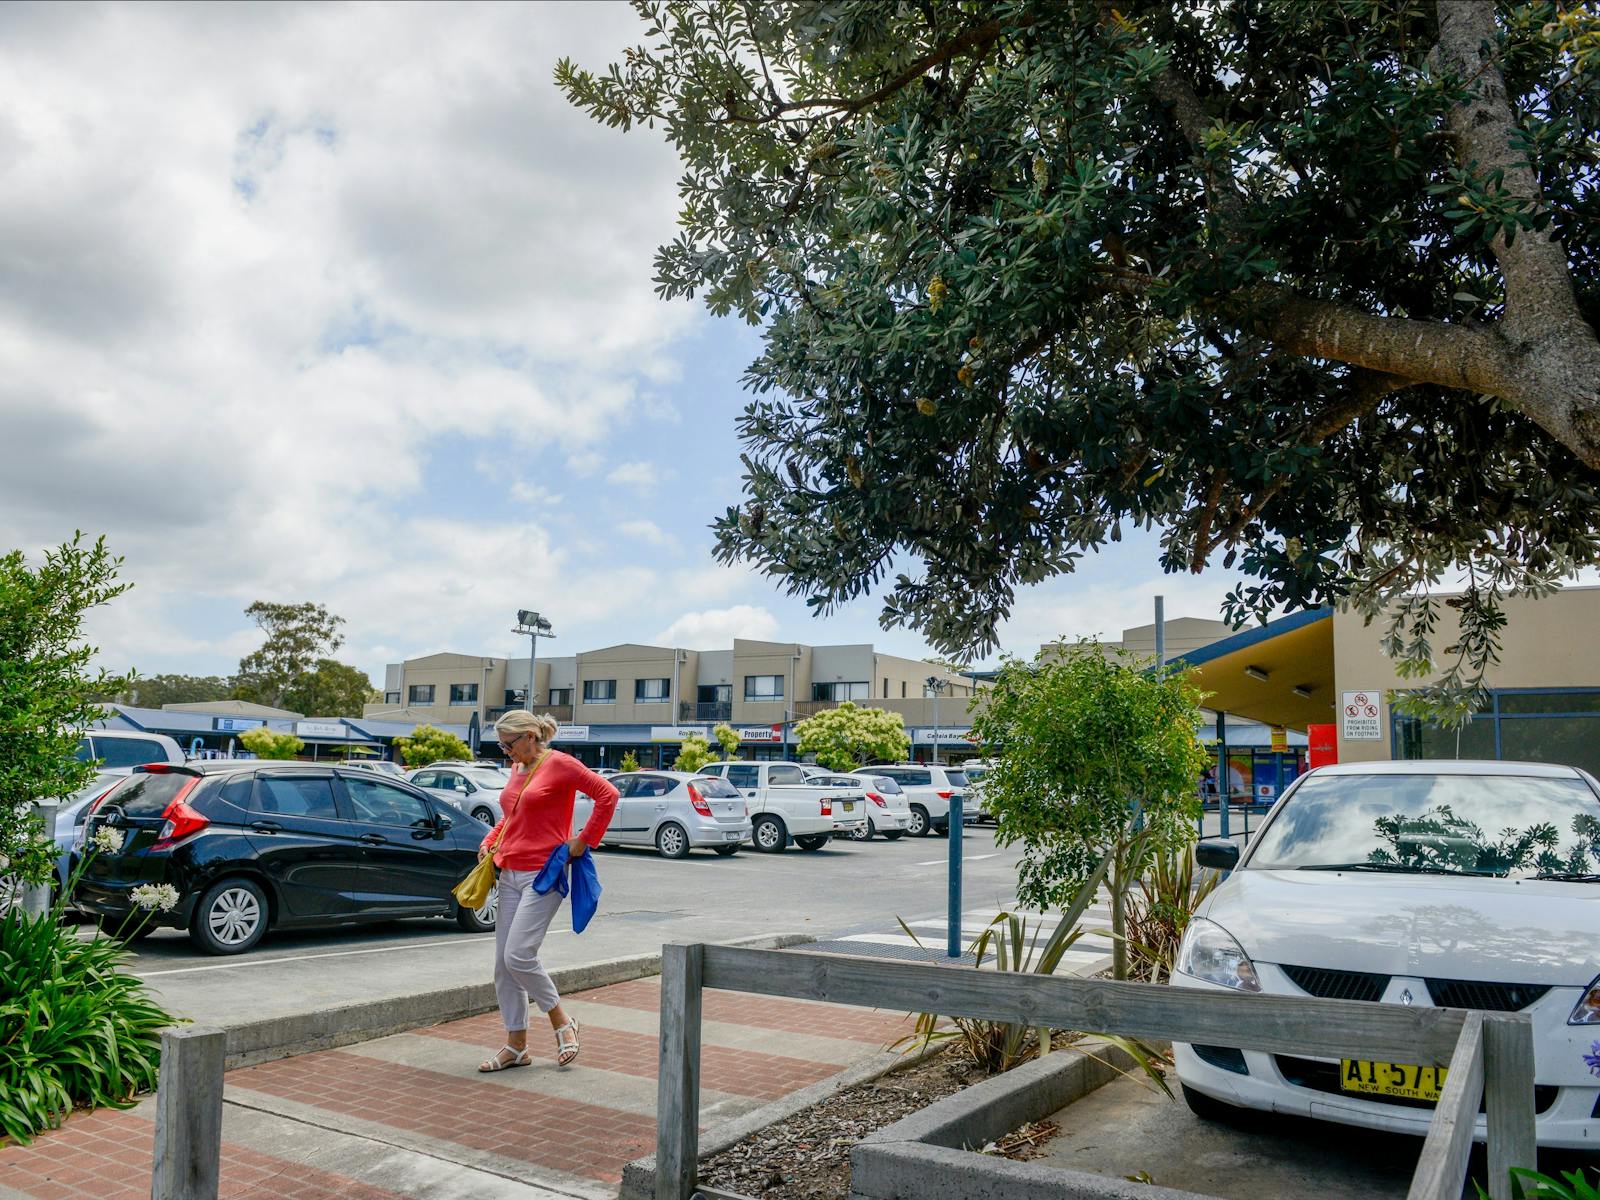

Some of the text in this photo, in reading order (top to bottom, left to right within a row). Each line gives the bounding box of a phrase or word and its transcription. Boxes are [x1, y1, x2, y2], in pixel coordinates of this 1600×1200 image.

[744, 730, 773, 739] Property
[1358, 1083, 1379, 1092] NEW
[1385, 1086, 1418, 1096] SOUTH
